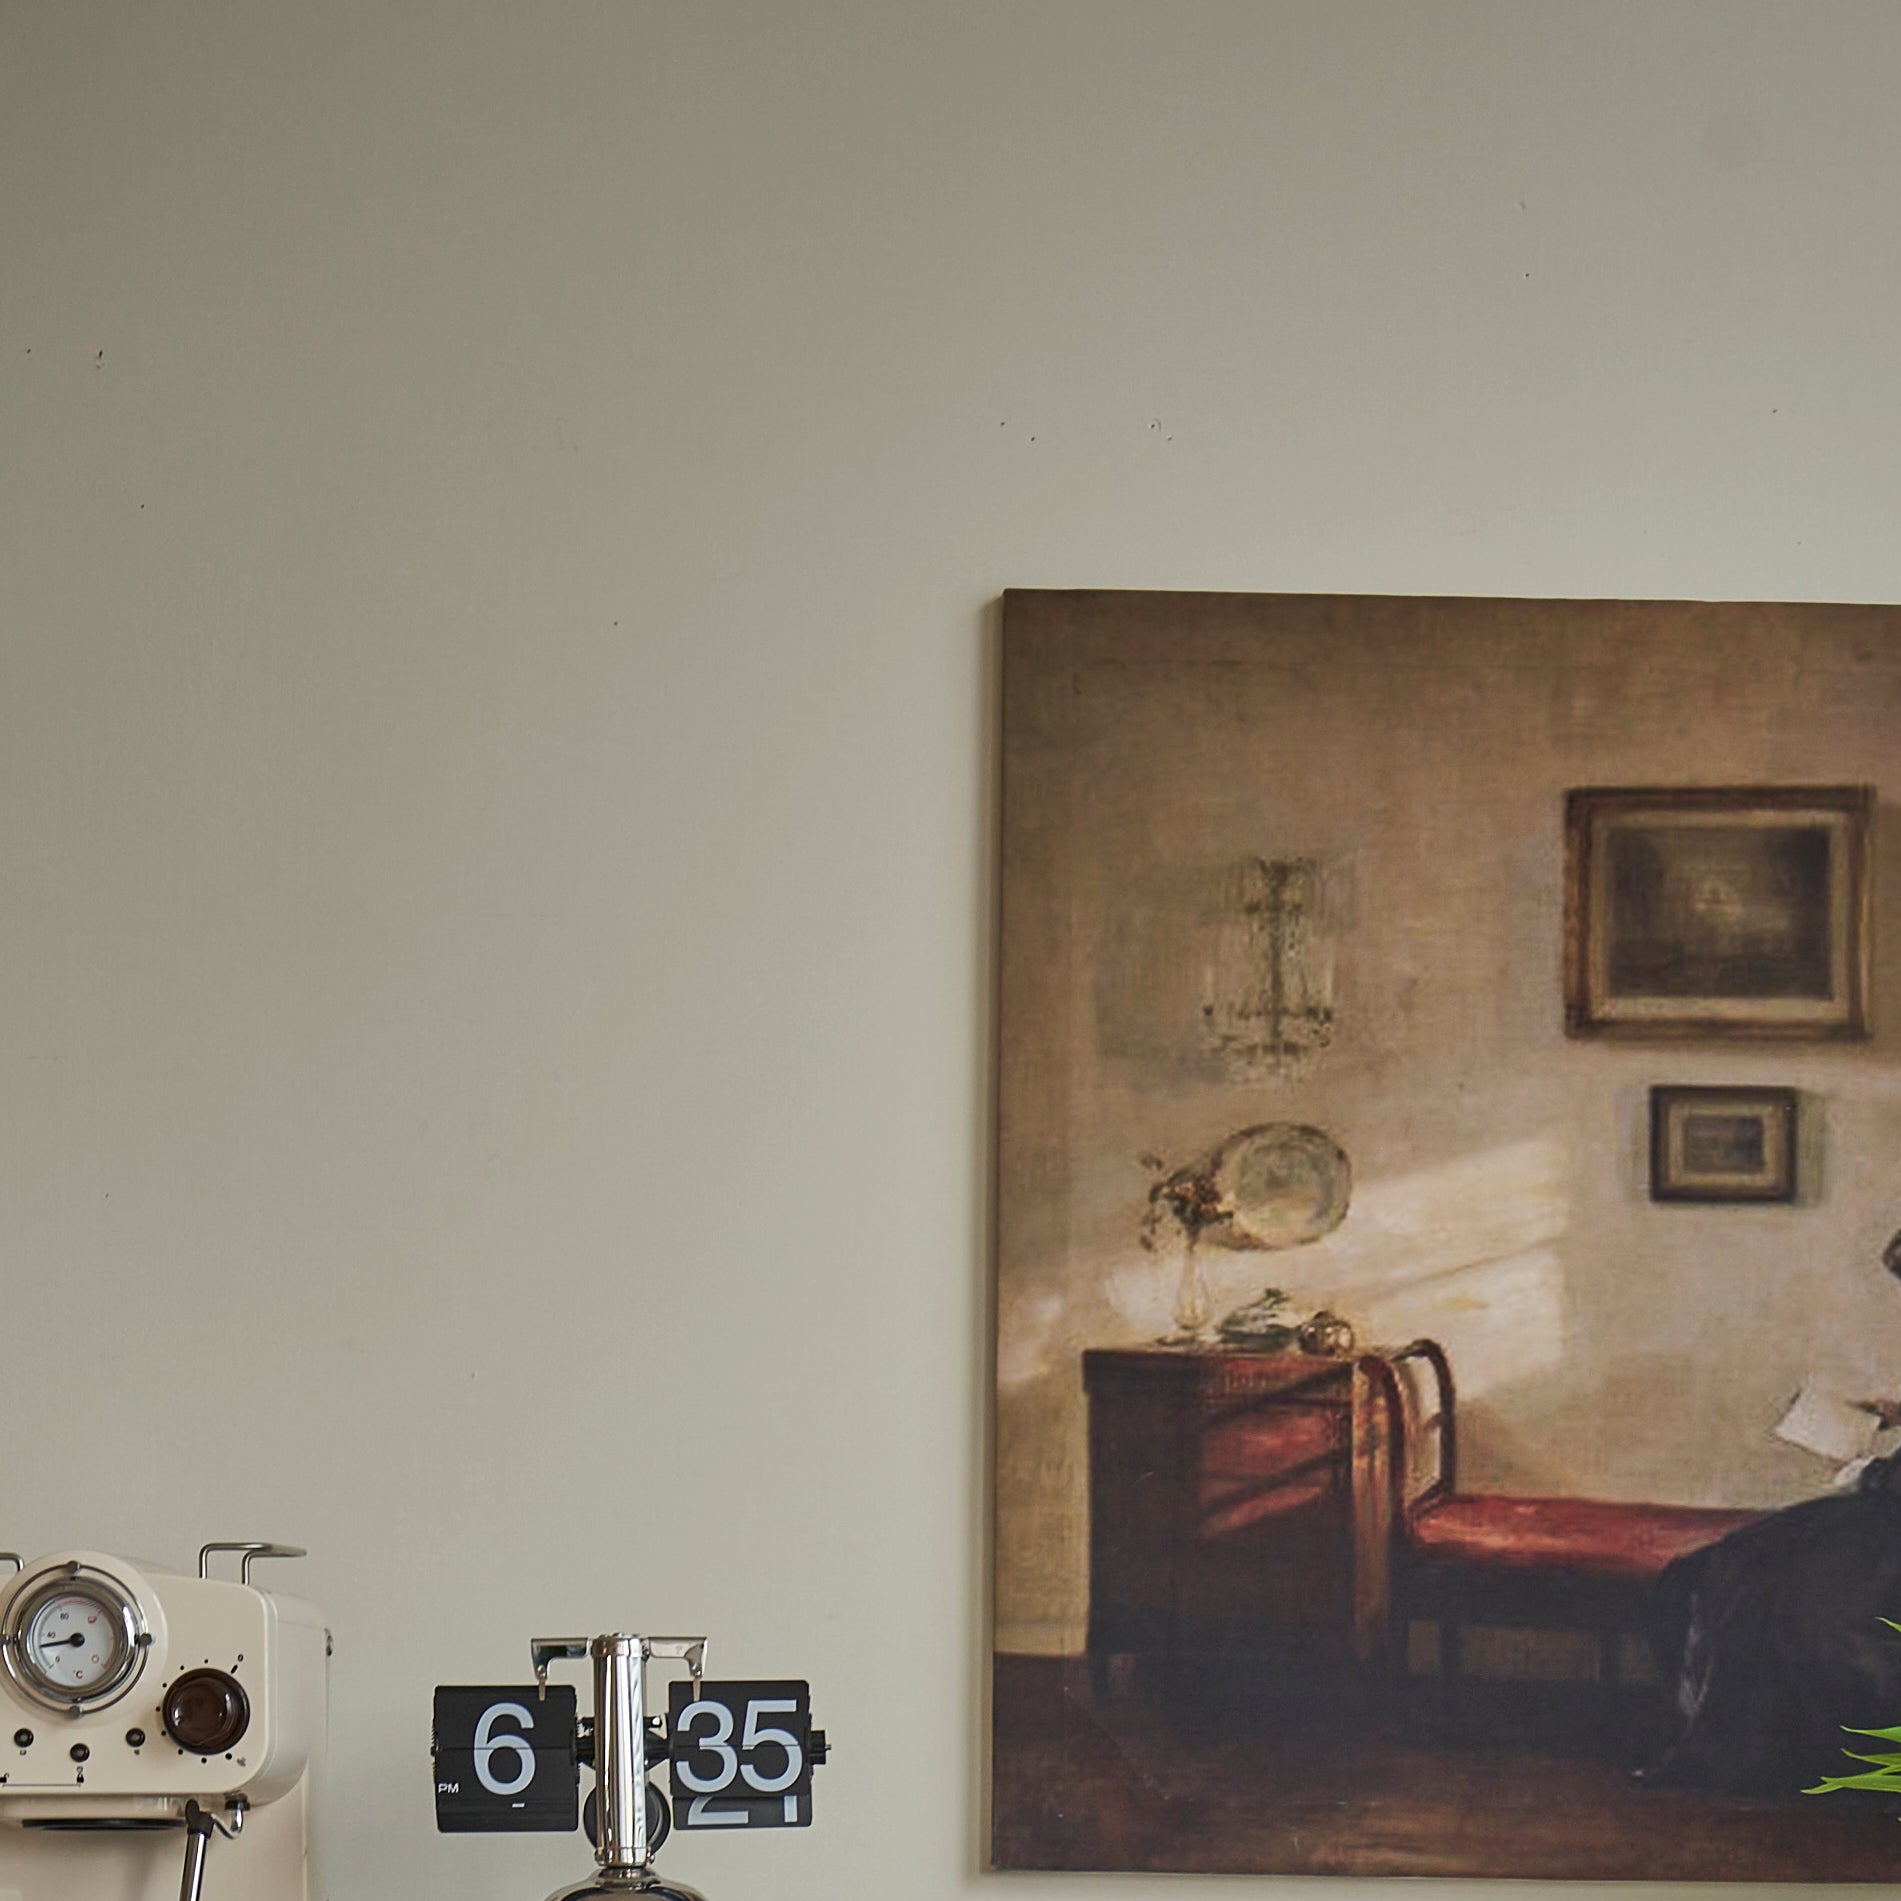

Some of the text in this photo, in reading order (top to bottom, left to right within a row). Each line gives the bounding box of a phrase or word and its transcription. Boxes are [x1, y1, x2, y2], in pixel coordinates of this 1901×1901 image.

[438, 1783, 459, 1794] PM
[473, 1702, 536, 1795] 6
[676, 1699, 803, 1793] 35
